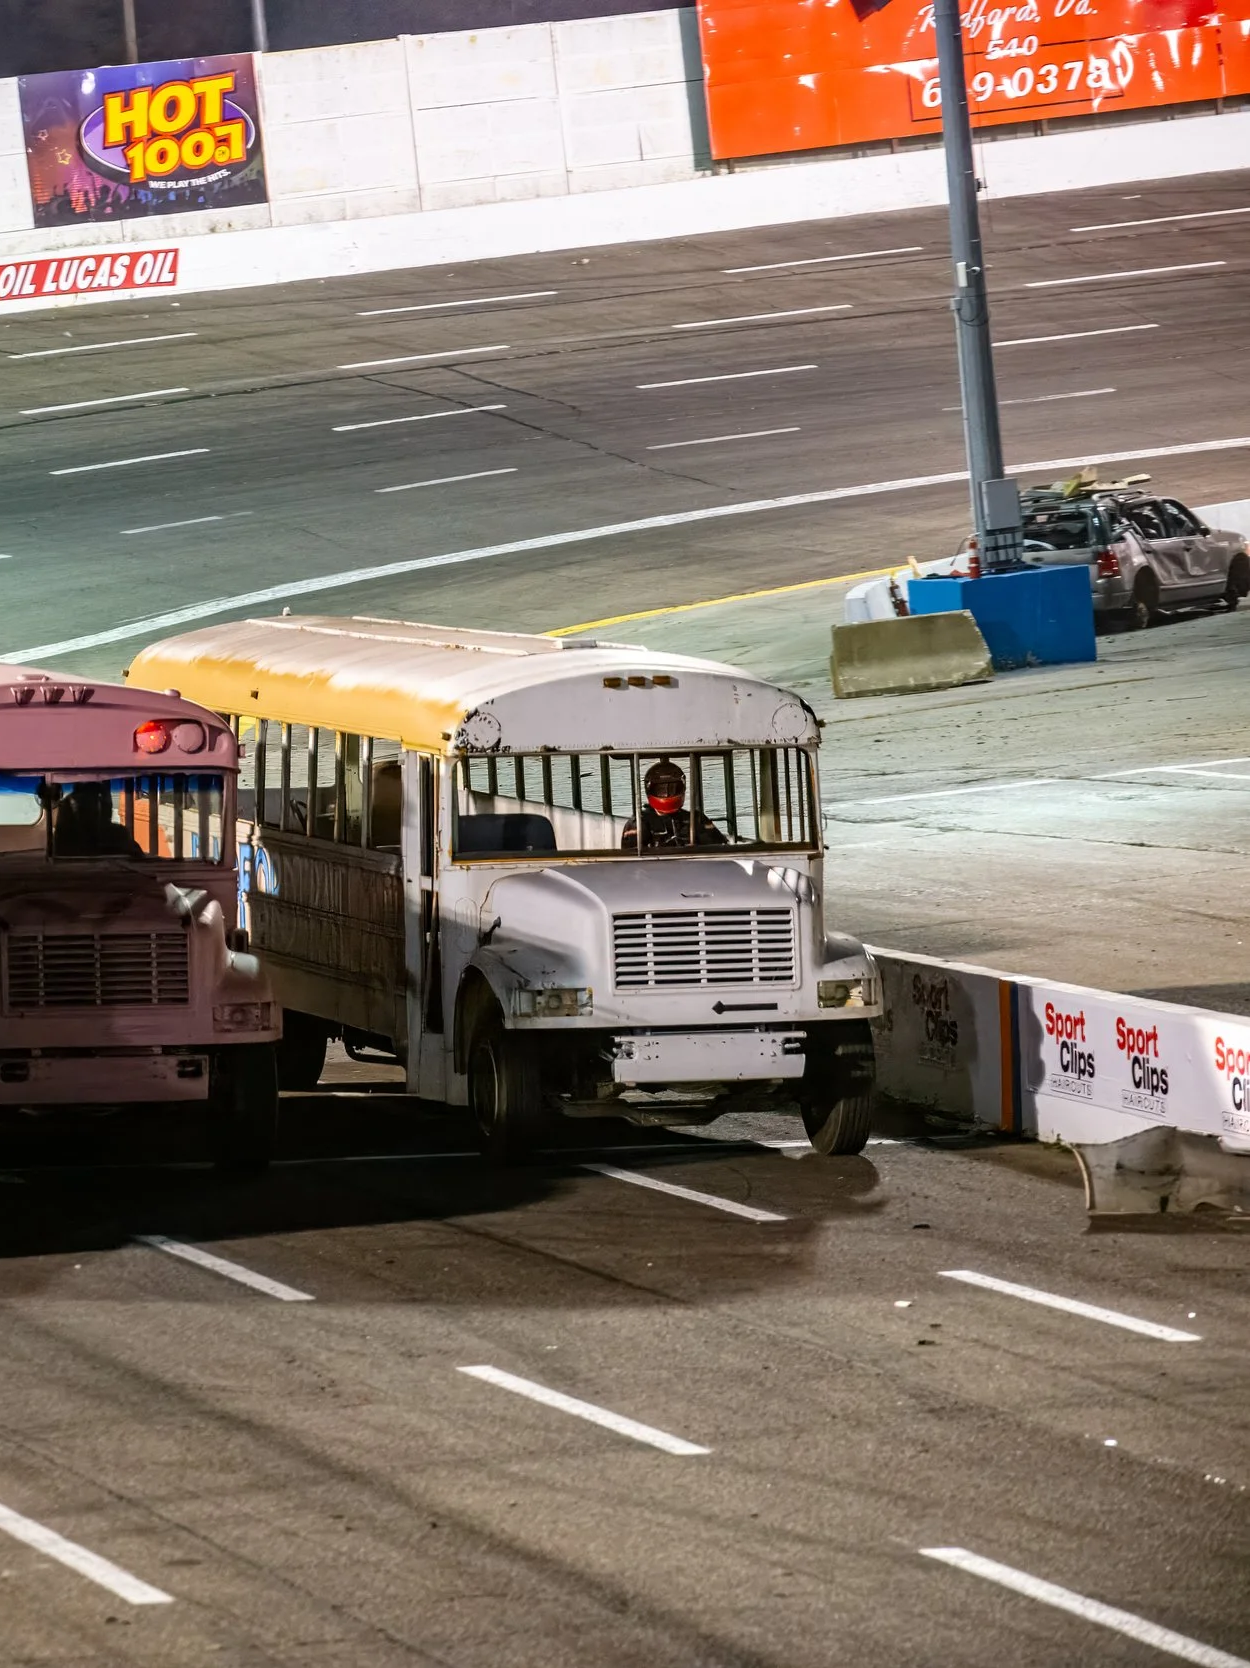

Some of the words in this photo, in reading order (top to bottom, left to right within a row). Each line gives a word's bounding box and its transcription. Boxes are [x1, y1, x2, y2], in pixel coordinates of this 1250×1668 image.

[918, 0, 1041, 39] Rdford,
[985, 36, 1038, 60] 540
[922, 58, 1110, 108] 69-0378
[104, 73, 235, 147] HOT
[148, 180, 166, 189] WE
[167, 180, 190, 189] PLAY
[190, 176, 207, 187] THE
[42, 254, 131, 293] LUCAS
[133, 252, 176, 285] OIL
[1045, 1002, 1086, 1045] Sport
[1116, 1016, 1159, 1060] Sport
[1060, 1040, 1095, 1080] Clips
[1132, 1056, 1169, 1096] Clips
